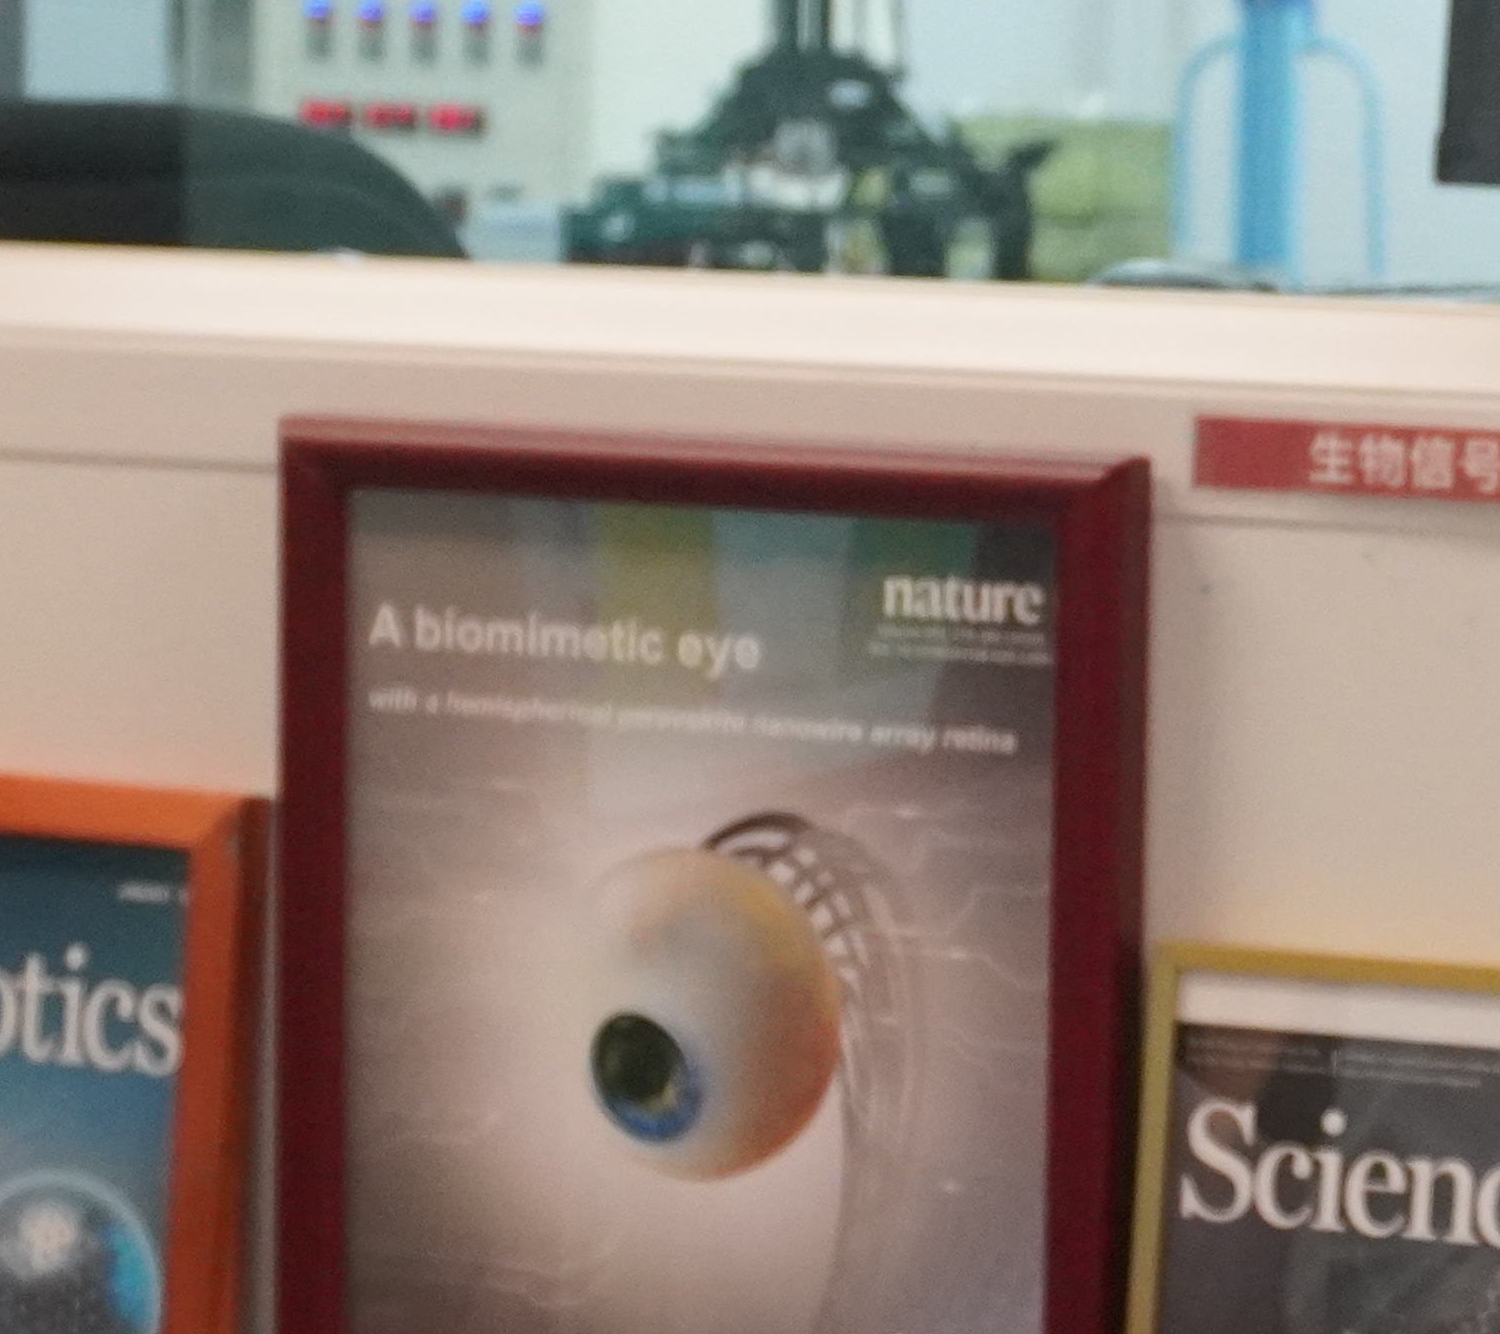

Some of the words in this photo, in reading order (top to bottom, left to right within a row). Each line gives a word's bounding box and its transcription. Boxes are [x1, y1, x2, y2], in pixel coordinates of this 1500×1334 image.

[883, 573, 1046, 625] nature
[368, 601, 398, 646] A
[414, 603, 666, 666] biomimetic
[677, 630, 763, 681] eye
[368, 685, 418, 713] with
[869, 722, 936, 756] array
